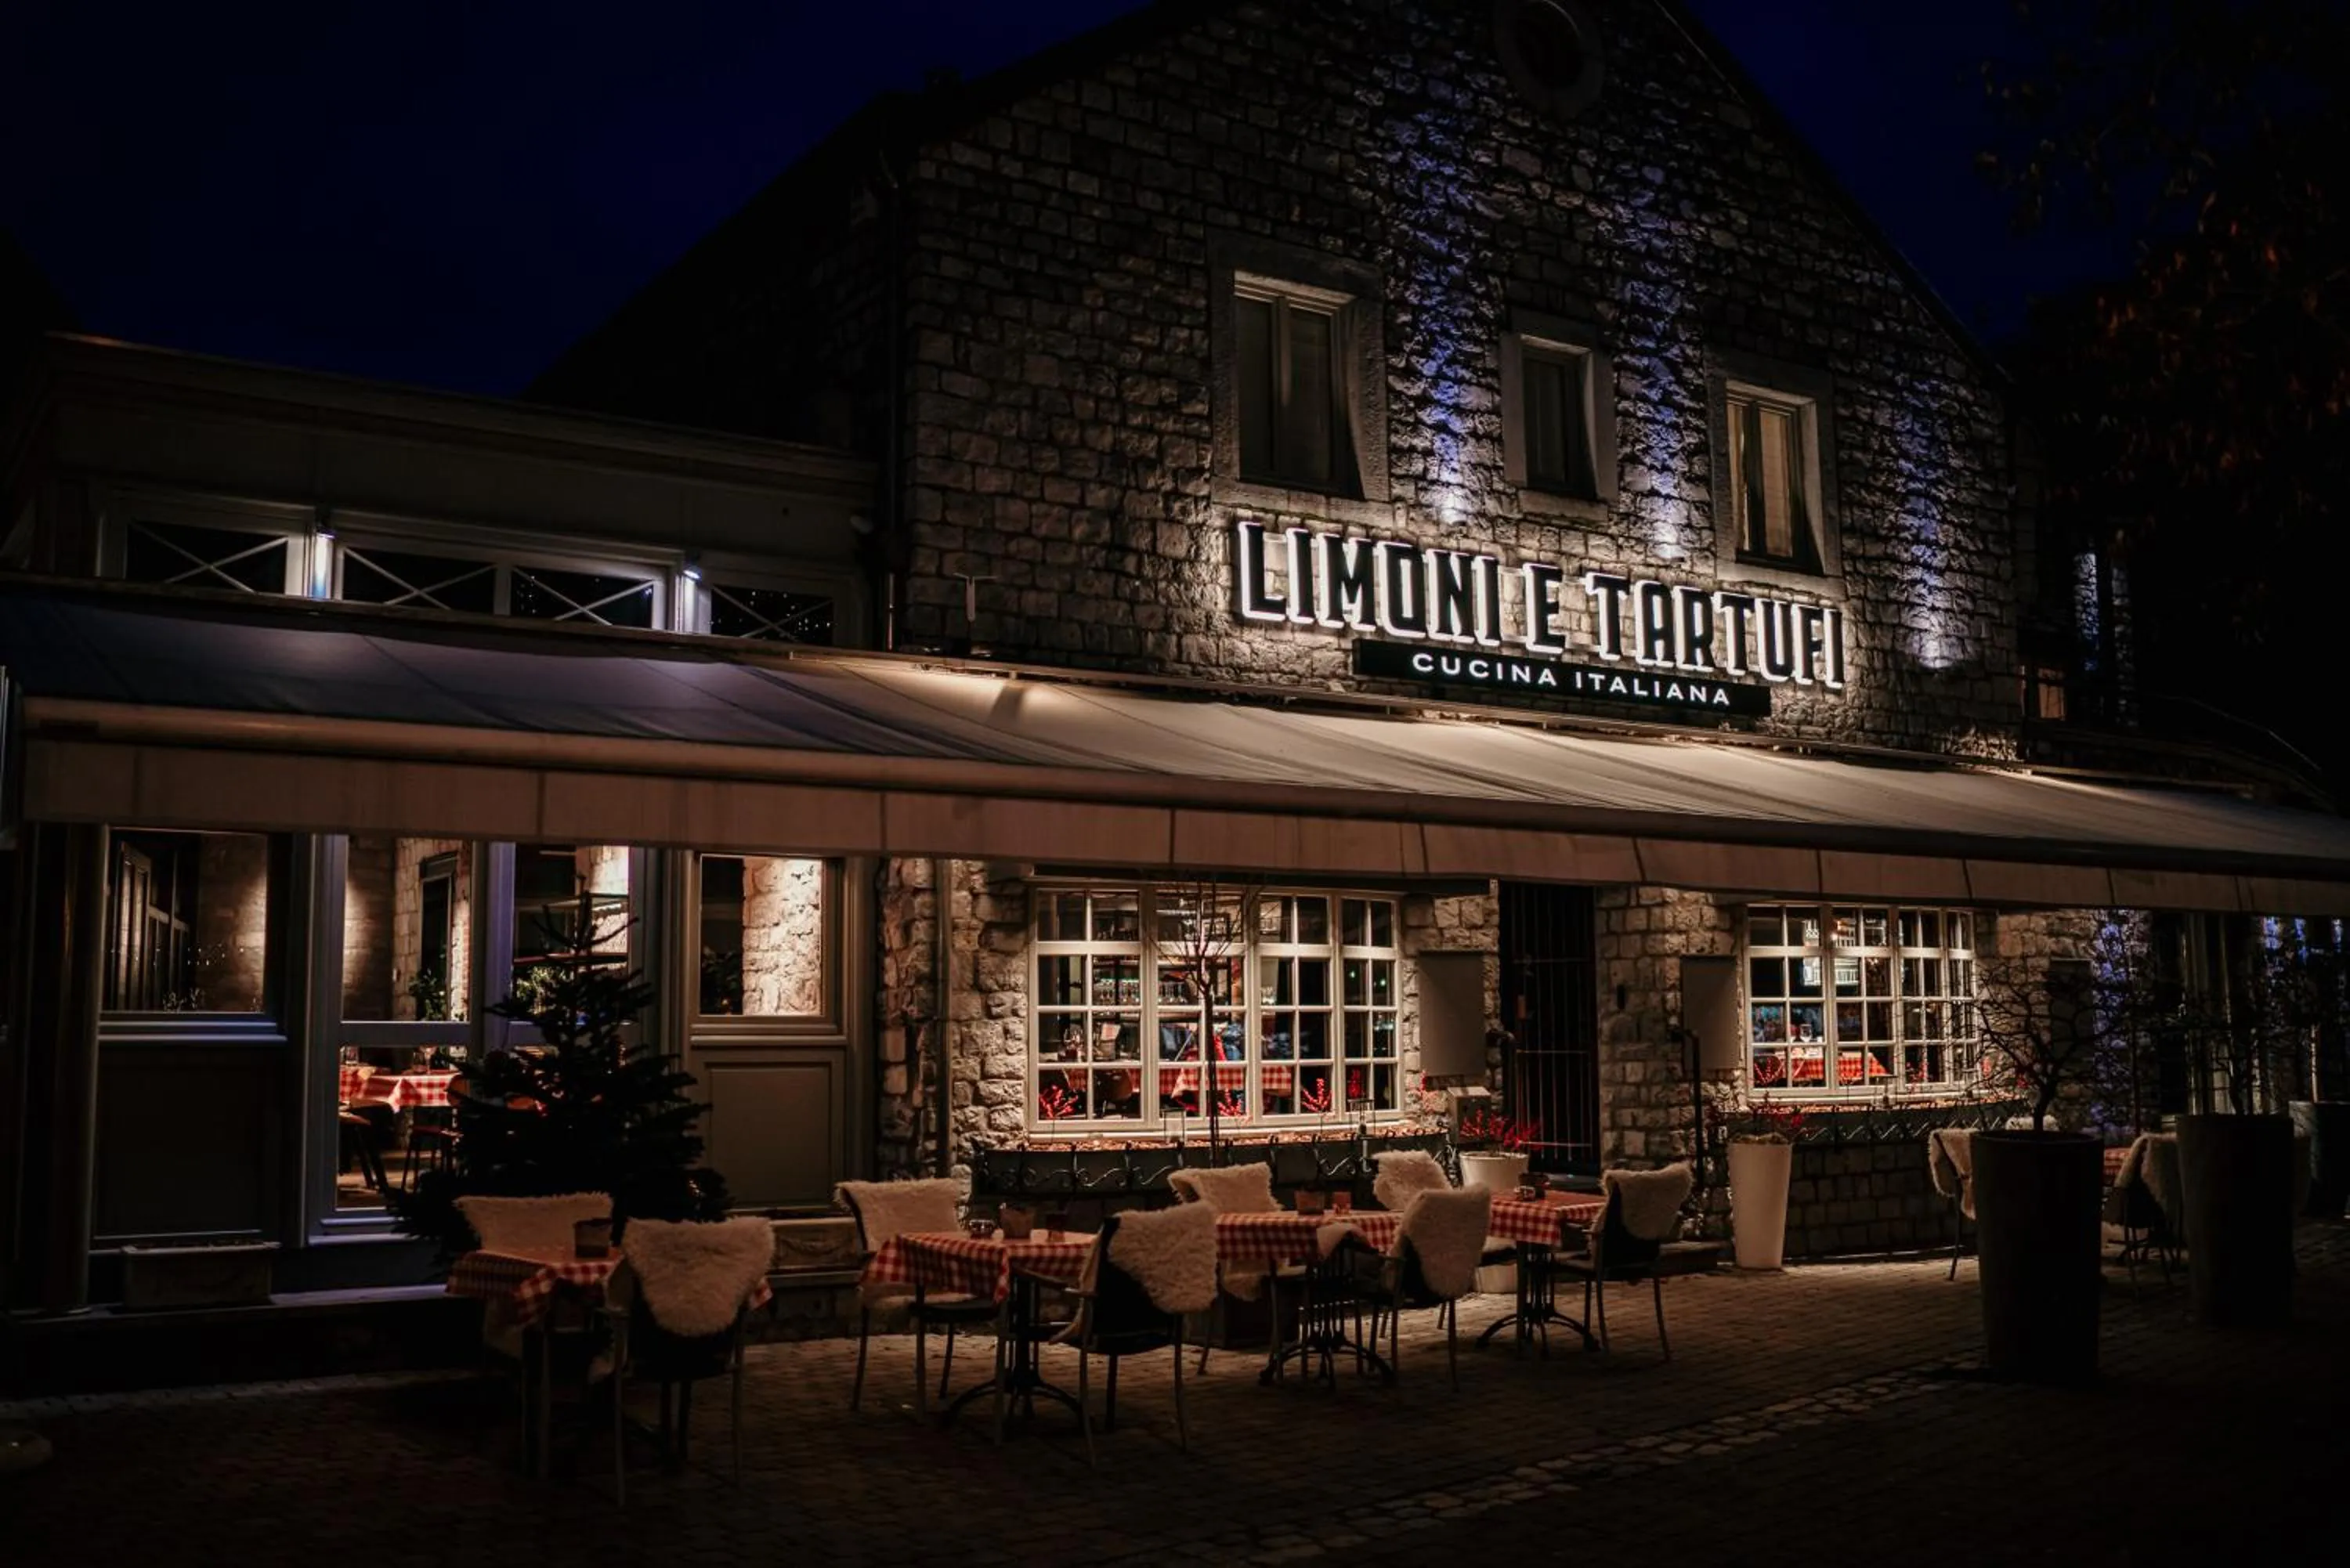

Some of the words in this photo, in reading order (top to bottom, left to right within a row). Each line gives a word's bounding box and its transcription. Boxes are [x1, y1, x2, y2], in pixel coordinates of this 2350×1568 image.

[1238, 521, 1500, 647] LIMONI
[1521, 562, 1567, 655] E
[1585, 572, 1845, 689] TARTUFI
[1412, 652, 1556, 686] CUCINA
[1575, 671, 1730, 706] ITALIANA
